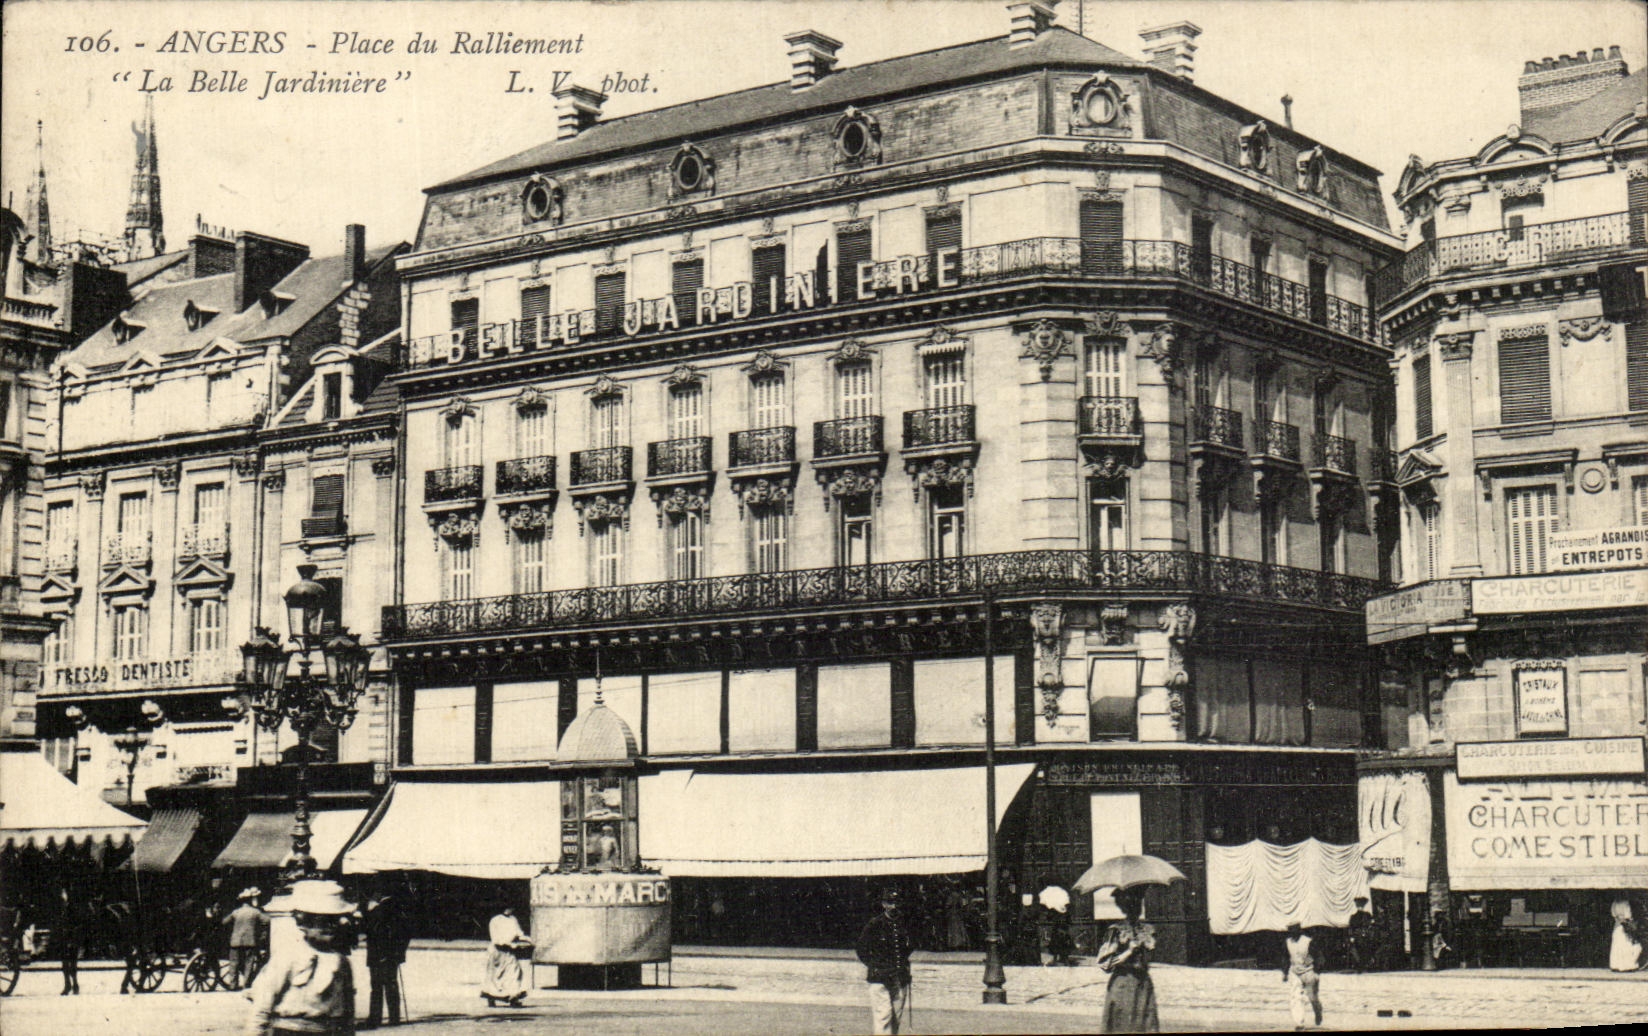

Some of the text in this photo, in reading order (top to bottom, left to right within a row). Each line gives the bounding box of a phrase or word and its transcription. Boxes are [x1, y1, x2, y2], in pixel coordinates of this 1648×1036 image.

[447, 308, 580, 364] BELLE
[1562, 547, 1644, 566] ENTREPOTS
[1479, 574, 1636, 598] CHARCUTERIE
[121, 658, 191, 681] DENTISTE
[1584, 740, 1639, 755] CUISINE
